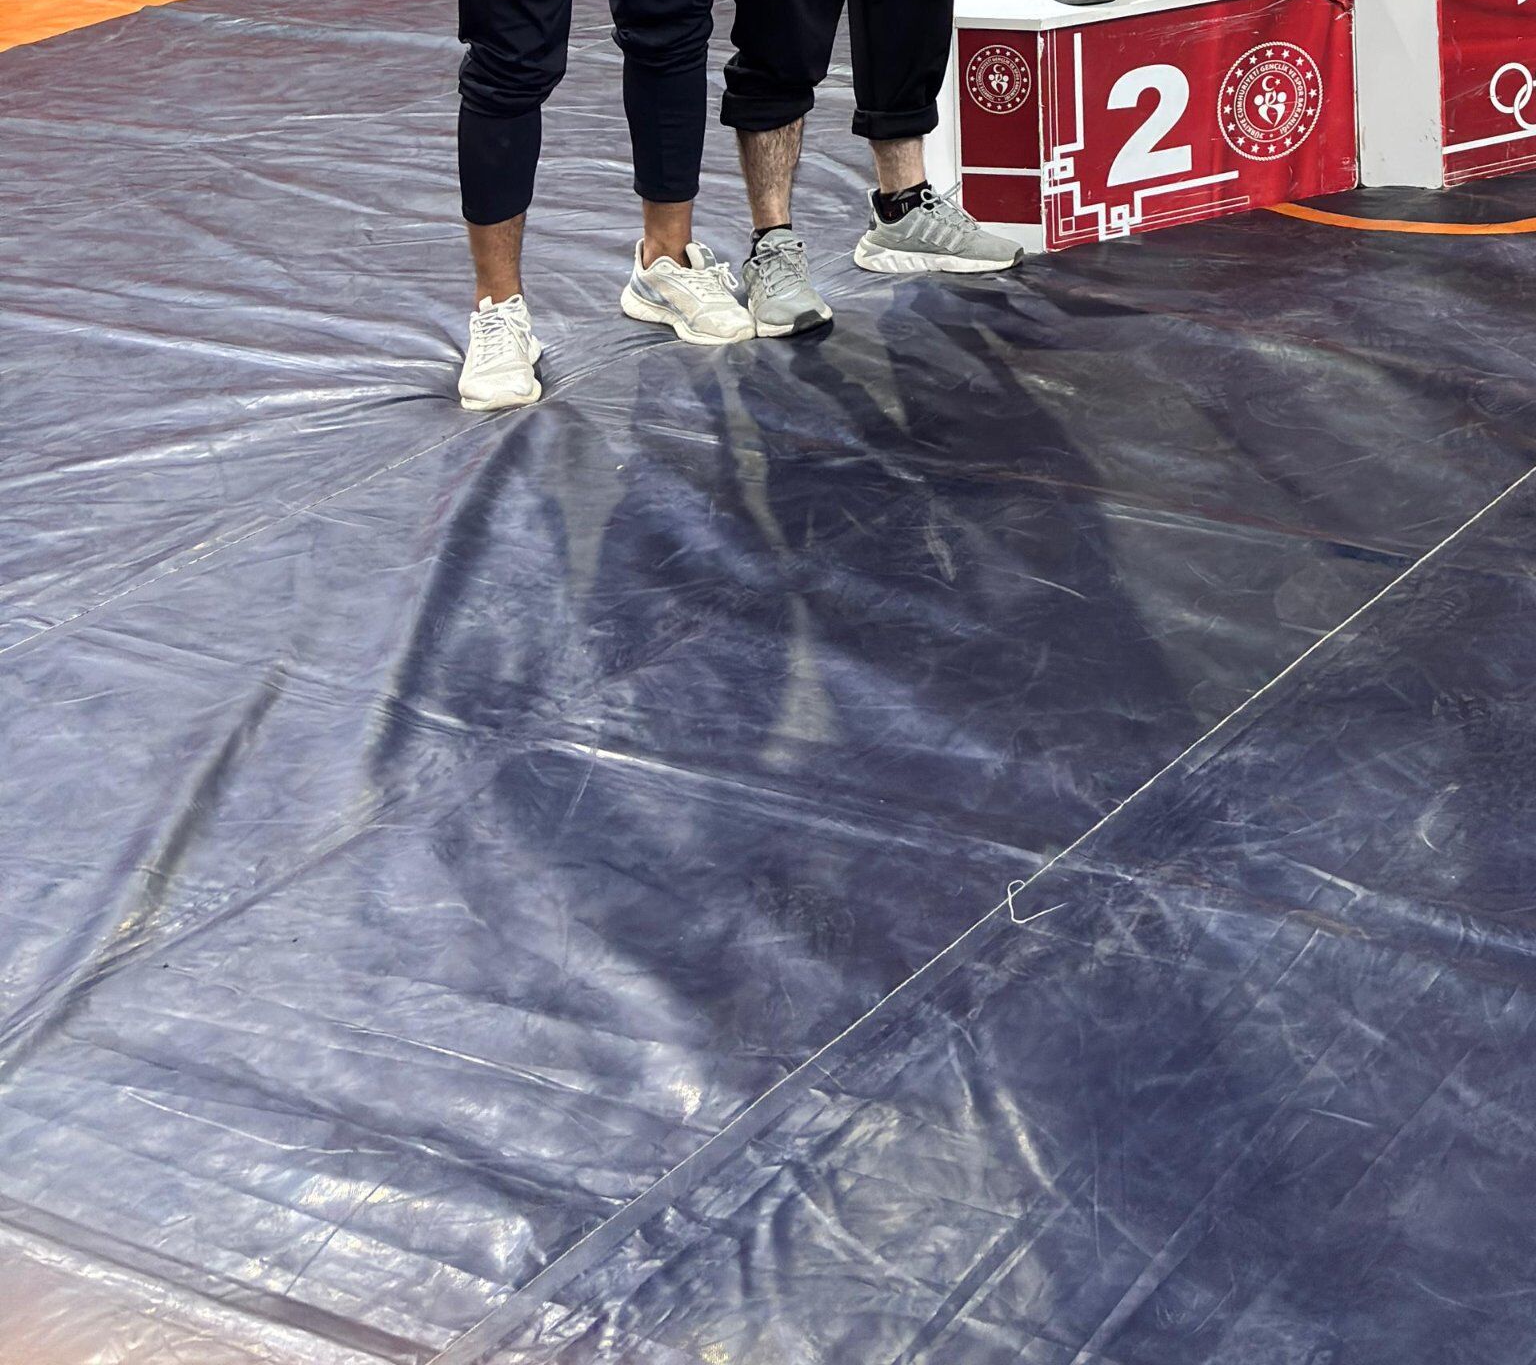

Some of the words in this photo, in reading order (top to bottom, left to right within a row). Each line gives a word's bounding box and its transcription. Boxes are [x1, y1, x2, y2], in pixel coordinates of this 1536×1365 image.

[1106, 64, 1194, 186] 2
[1239, 117, 1266, 140] TÜRKİYE
[1259, 63, 1289, 73] GENÇLİK
[1280, 97, 1305, 134] BAKANLIĞI
